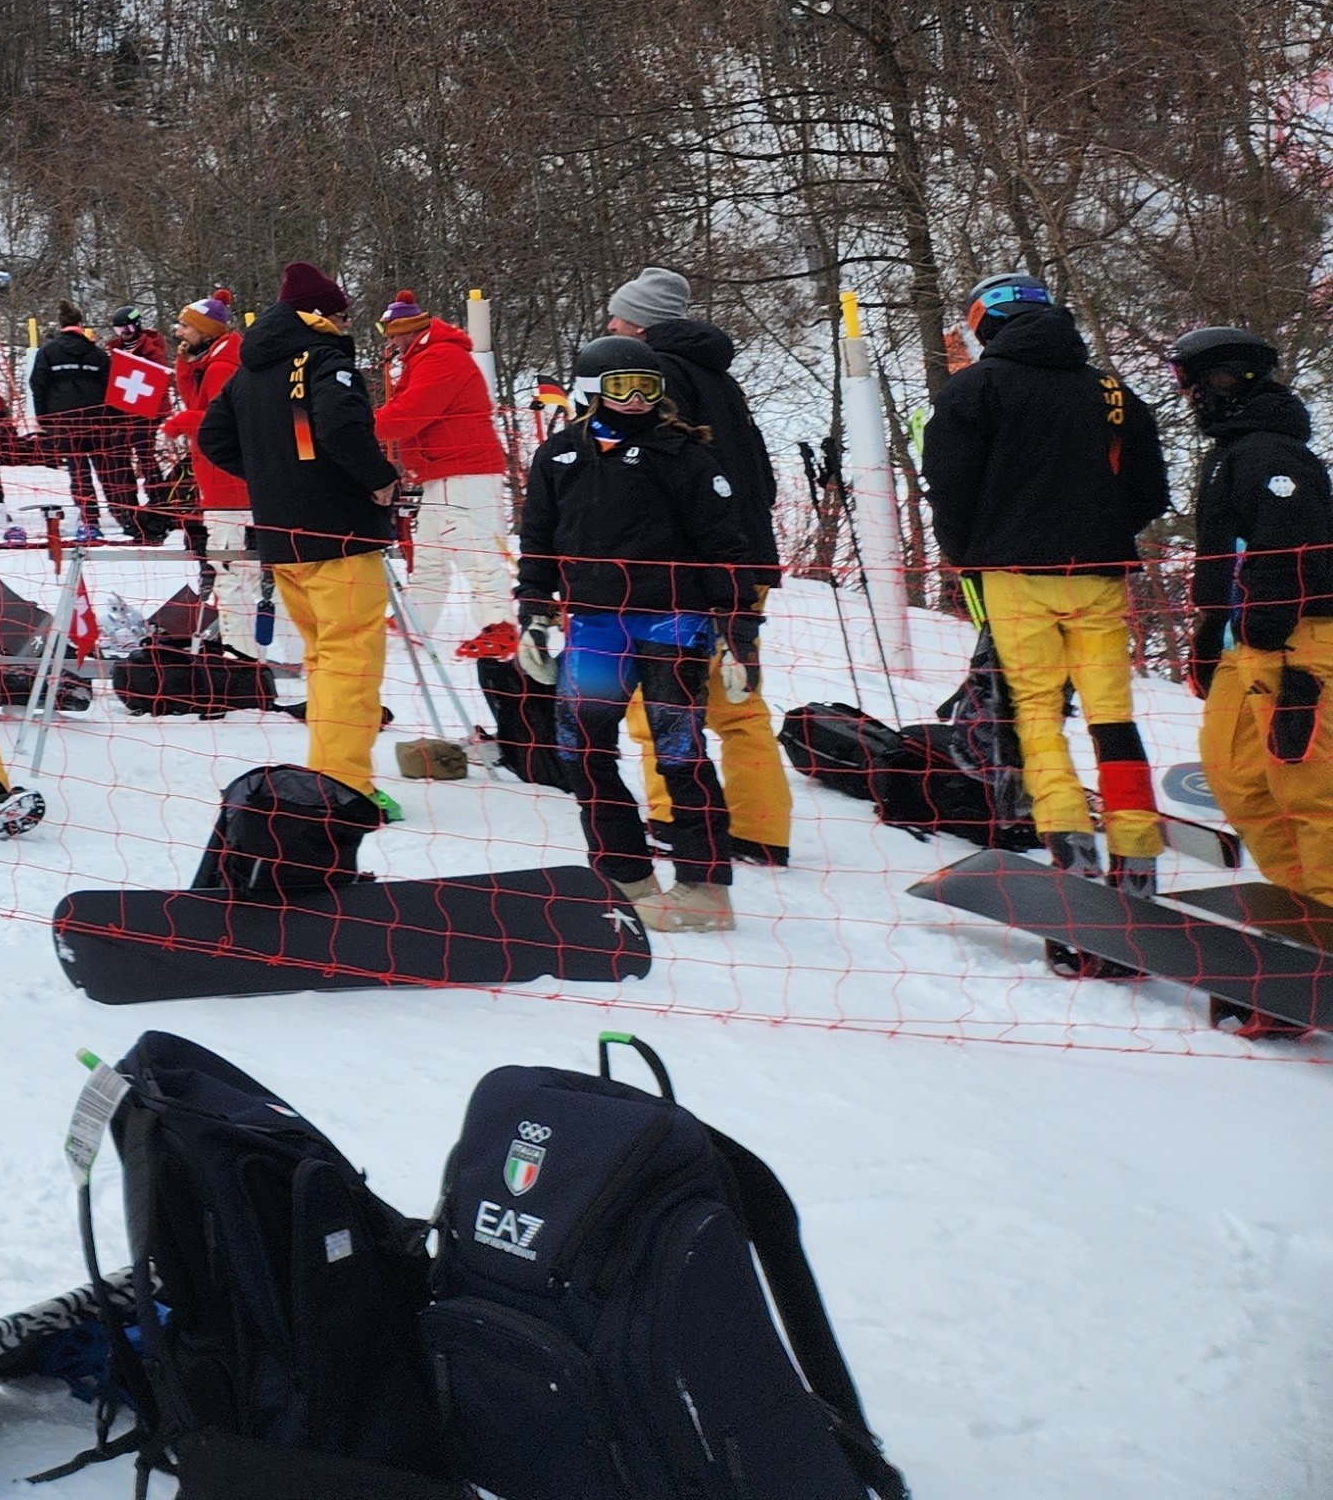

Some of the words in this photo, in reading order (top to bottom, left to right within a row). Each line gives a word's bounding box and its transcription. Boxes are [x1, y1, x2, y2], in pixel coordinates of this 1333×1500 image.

[289, 350, 310, 399] GER
[1099, 374, 1124, 425] GER
[474, 1200, 546, 1248] EA7
